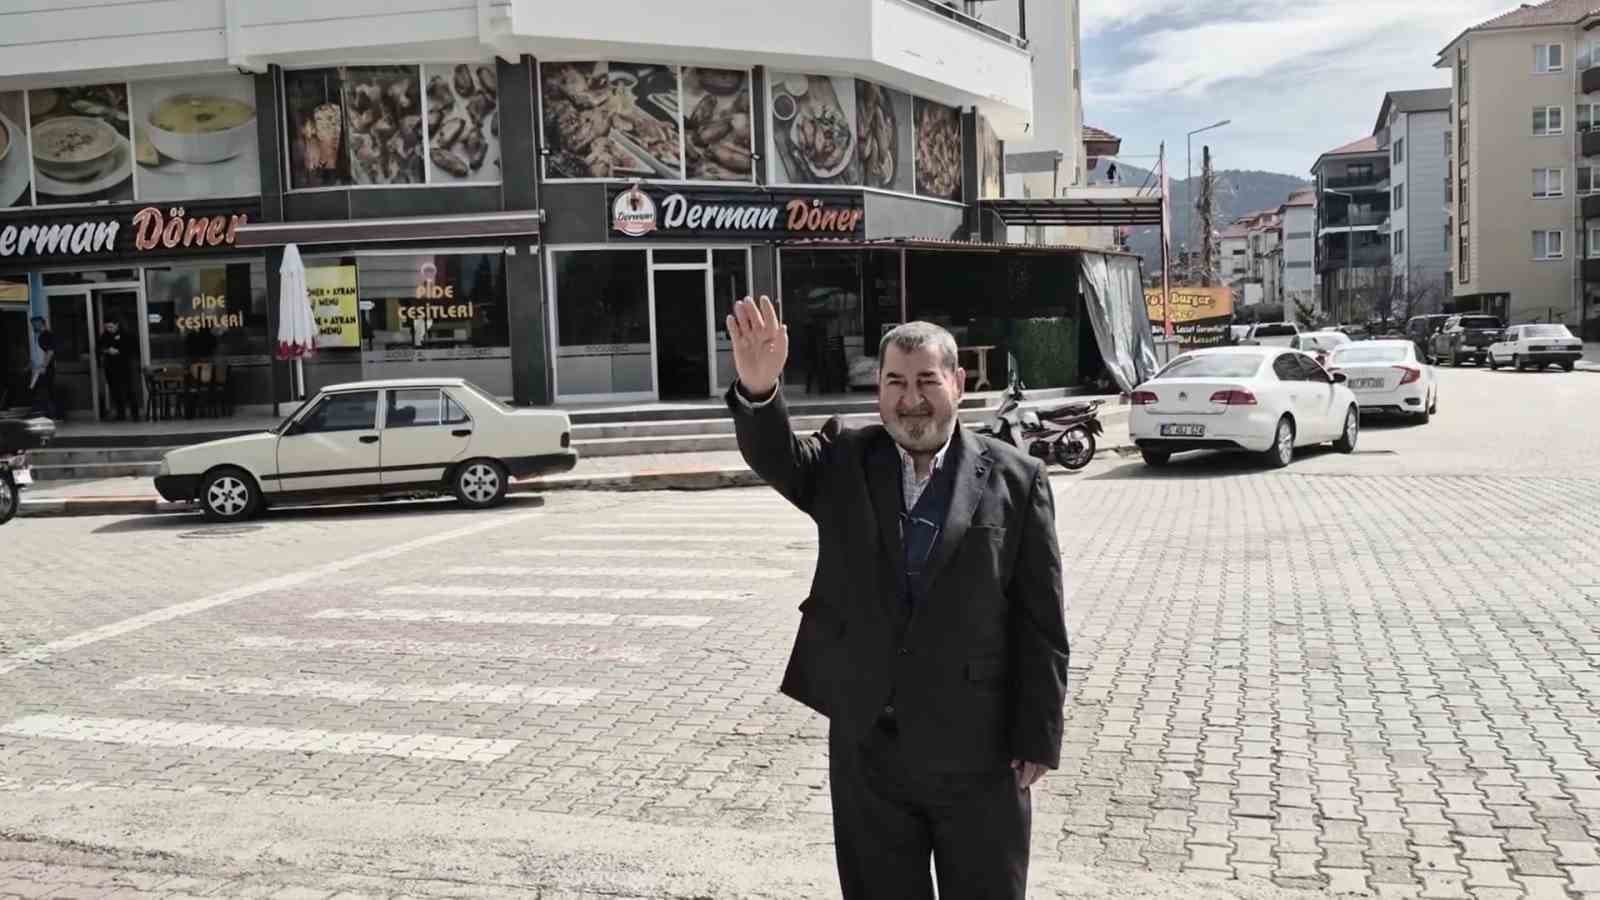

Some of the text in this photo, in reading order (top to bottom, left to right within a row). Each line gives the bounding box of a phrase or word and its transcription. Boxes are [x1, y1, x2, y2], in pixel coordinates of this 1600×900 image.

[661, 193, 864, 232] Derman Döner
[0, 206, 248, 257] erman Döner
[416, 281, 454, 299] PİDE
[1171, 292, 1212, 306] Burger
[192, 293, 225, 310] PİDE
